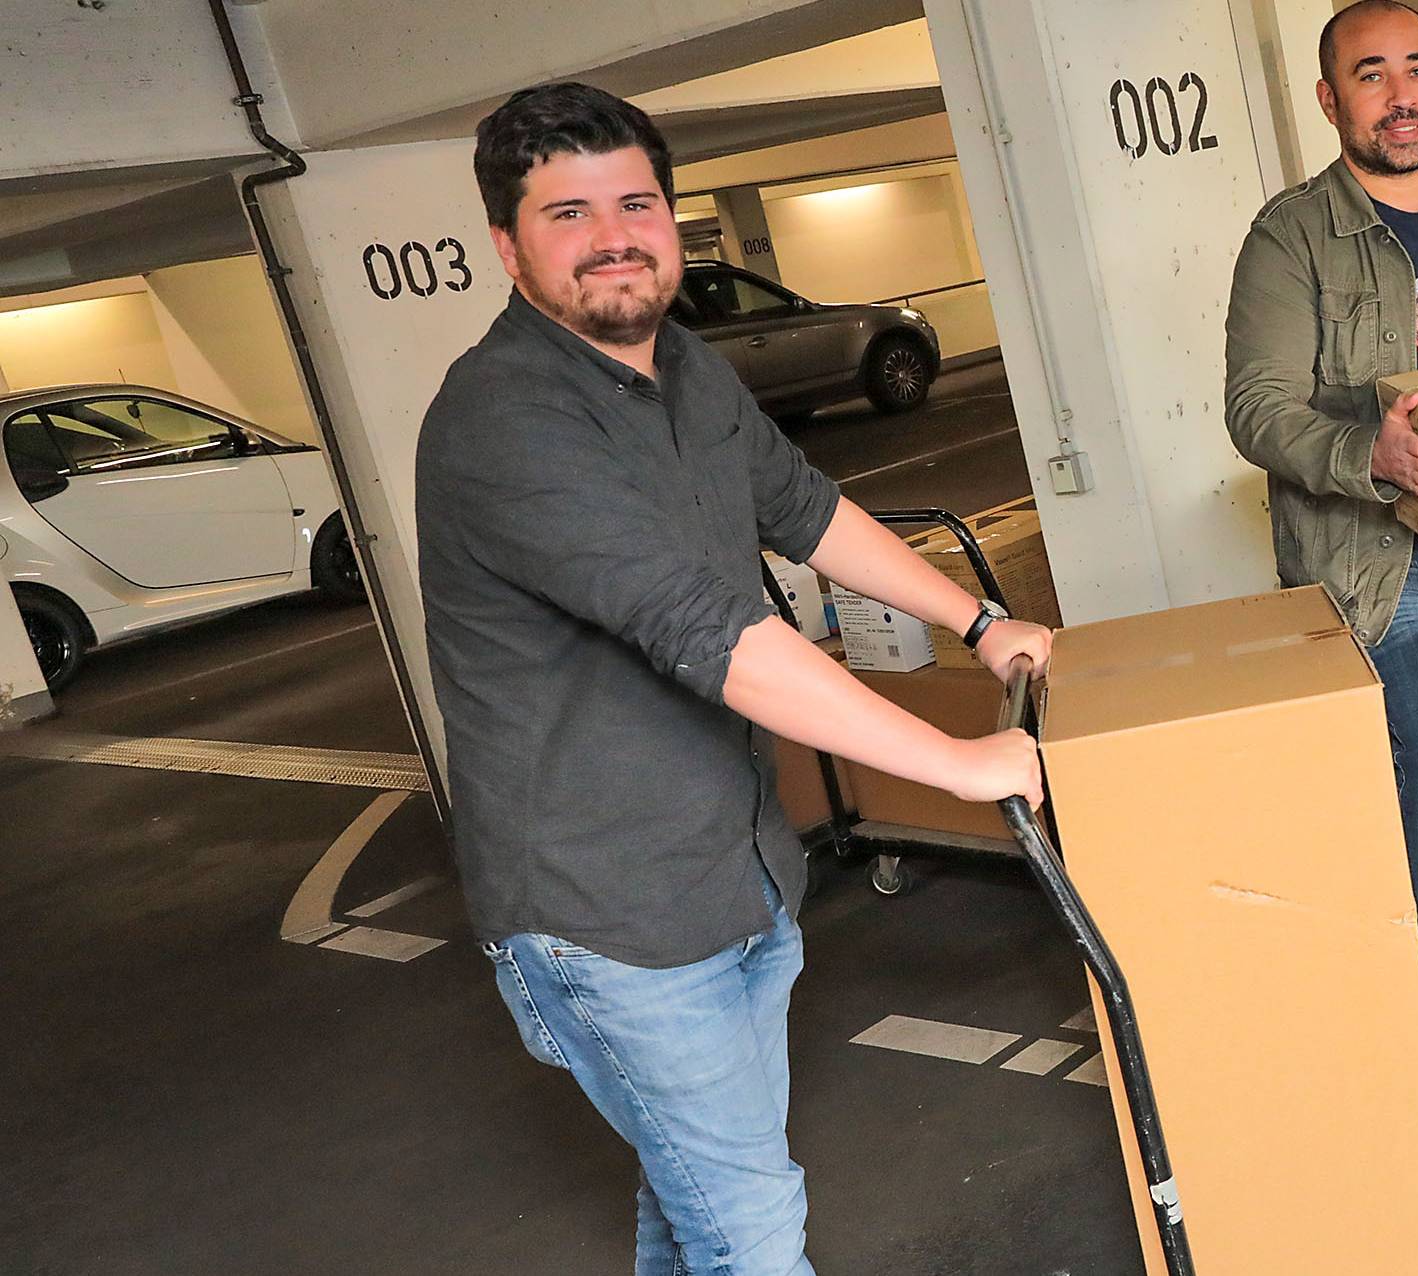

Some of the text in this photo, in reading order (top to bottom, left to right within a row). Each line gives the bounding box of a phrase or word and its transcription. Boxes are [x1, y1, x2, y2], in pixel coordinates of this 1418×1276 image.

[1110, 72, 1218, 159] 002
[363, 237, 472, 300] 003
[744, 237, 770, 255] 008
